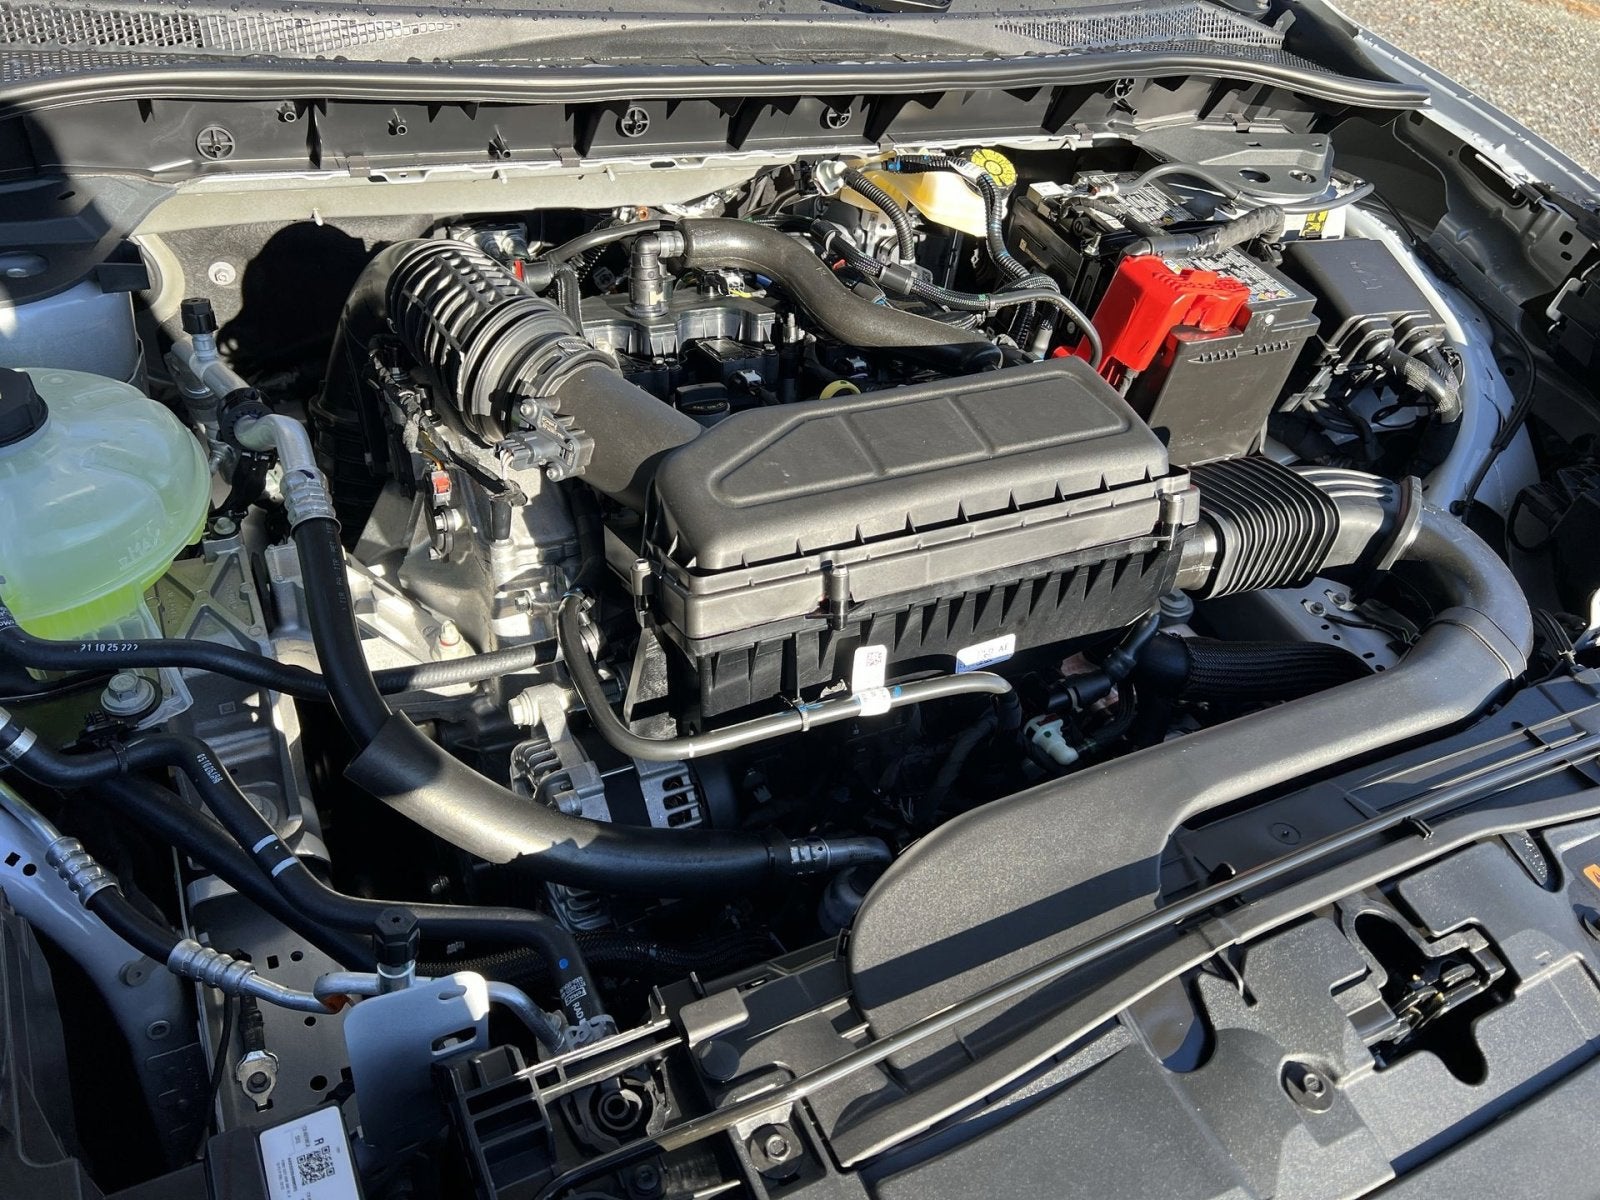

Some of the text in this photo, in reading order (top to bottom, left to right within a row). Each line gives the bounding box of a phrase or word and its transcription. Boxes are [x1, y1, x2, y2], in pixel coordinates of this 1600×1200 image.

[95, 643, 106, 652] 10
[107, 643, 119, 652] 25
[572, 1001, 584, 1018] RAD
[314, 1137, 325, 1146] R
